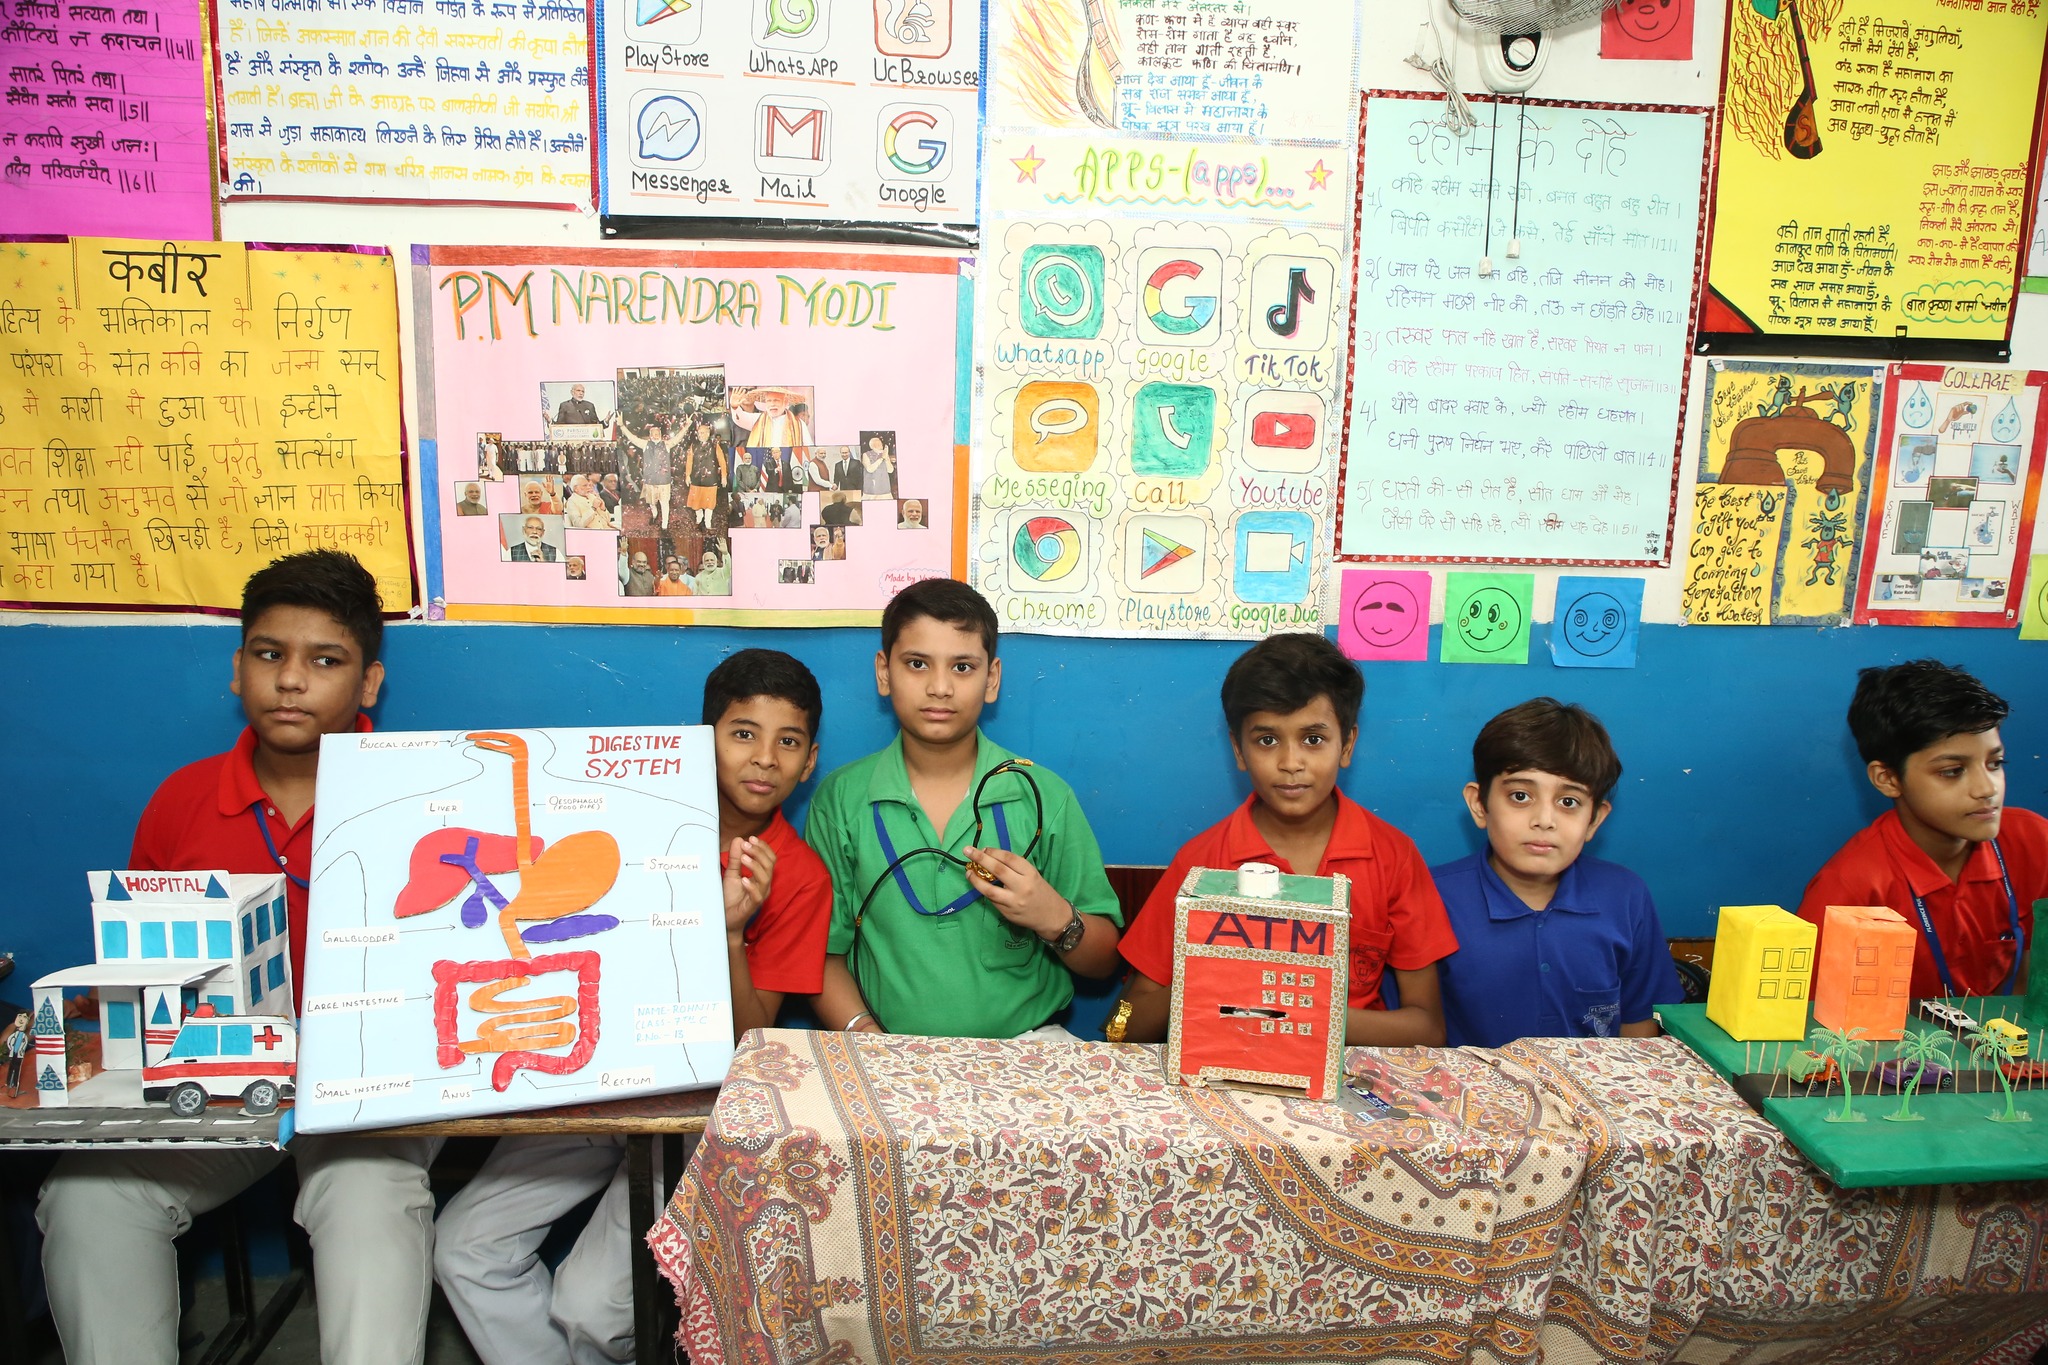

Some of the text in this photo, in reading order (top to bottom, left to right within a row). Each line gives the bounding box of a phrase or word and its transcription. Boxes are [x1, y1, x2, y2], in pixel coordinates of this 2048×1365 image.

[328, 53, 342, 76] के
[475, 61, 490, 82] से
[259, 116, 272, 136] से
[423, 124, 436, 143] के
[761, 178, 816, 198] Mail
[879, 184, 945, 212] Google
[102, 242, 220, 297] कबीर
[551, 269, 762, 330] NARENDRA
[775, 275, 897, 331] MODI
[57, 292, 352, 339] के भक्तिकाल के निर्गुण
[10, 341, 386, 380] परंपरा के संत कवि का जन्म सन्
[1136, 348, 1209, 381] Google
[1944, 367, 2012, 390] COLLAGE
[61, 388, 103, 422] काशी
[159, 397, 204, 427] हुआ
[43, 438, 96, 479] शिक्षा
[208, 437, 262, 479] परंतु
[275, 433, 357, 469] सत्संग
[45, 474, 402, 517] तथा अनुभव से जो प्राप्त किया
[994, 475, 1106, 512] Messeging
[1134, 481, 1184, 504] Call
[1239, 476, 1323, 506] Youtube
[1704, 512, 1733, 536] gift
[7, 532, 56, 561] भाषा
[62, 521, 133, 555] पंचमेल
[250, 518, 290, 553] जिसे
[1716, 539, 1746, 567] give
[1748, 540, 1762, 559] to
[14, 564, 117, 592] कहा गया
[885, 574, 904, 582] Made
[907, 573, 915, 585] by
[1006, 597, 1096, 623] Chrome
[1126, 598, 1211, 630] Playstore
[1230, 603, 1319, 633] Google Duo
[360, 738, 398, 748] BUCCAL
[587, 736, 681, 754] DIGESTIVE
[585, 758, 681, 778] SYSTEM
[430, 803, 457, 812] LIVER
[549, 796, 603, 805] OESOPHAGUS
[650, 859, 698, 870] STOMACH
[125, 876, 206, 893] HOSPITAL
[652, 914, 699, 926] PANCREAS
[1205, 912, 1326, 955] ATM
[308, 1000, 339, 1012] LARGE
[315, 1083, 350, 1098] SMALL
[601, 1073, 650, 1086] RECTUM
[442, 1090, 470, 1099] ANUS
